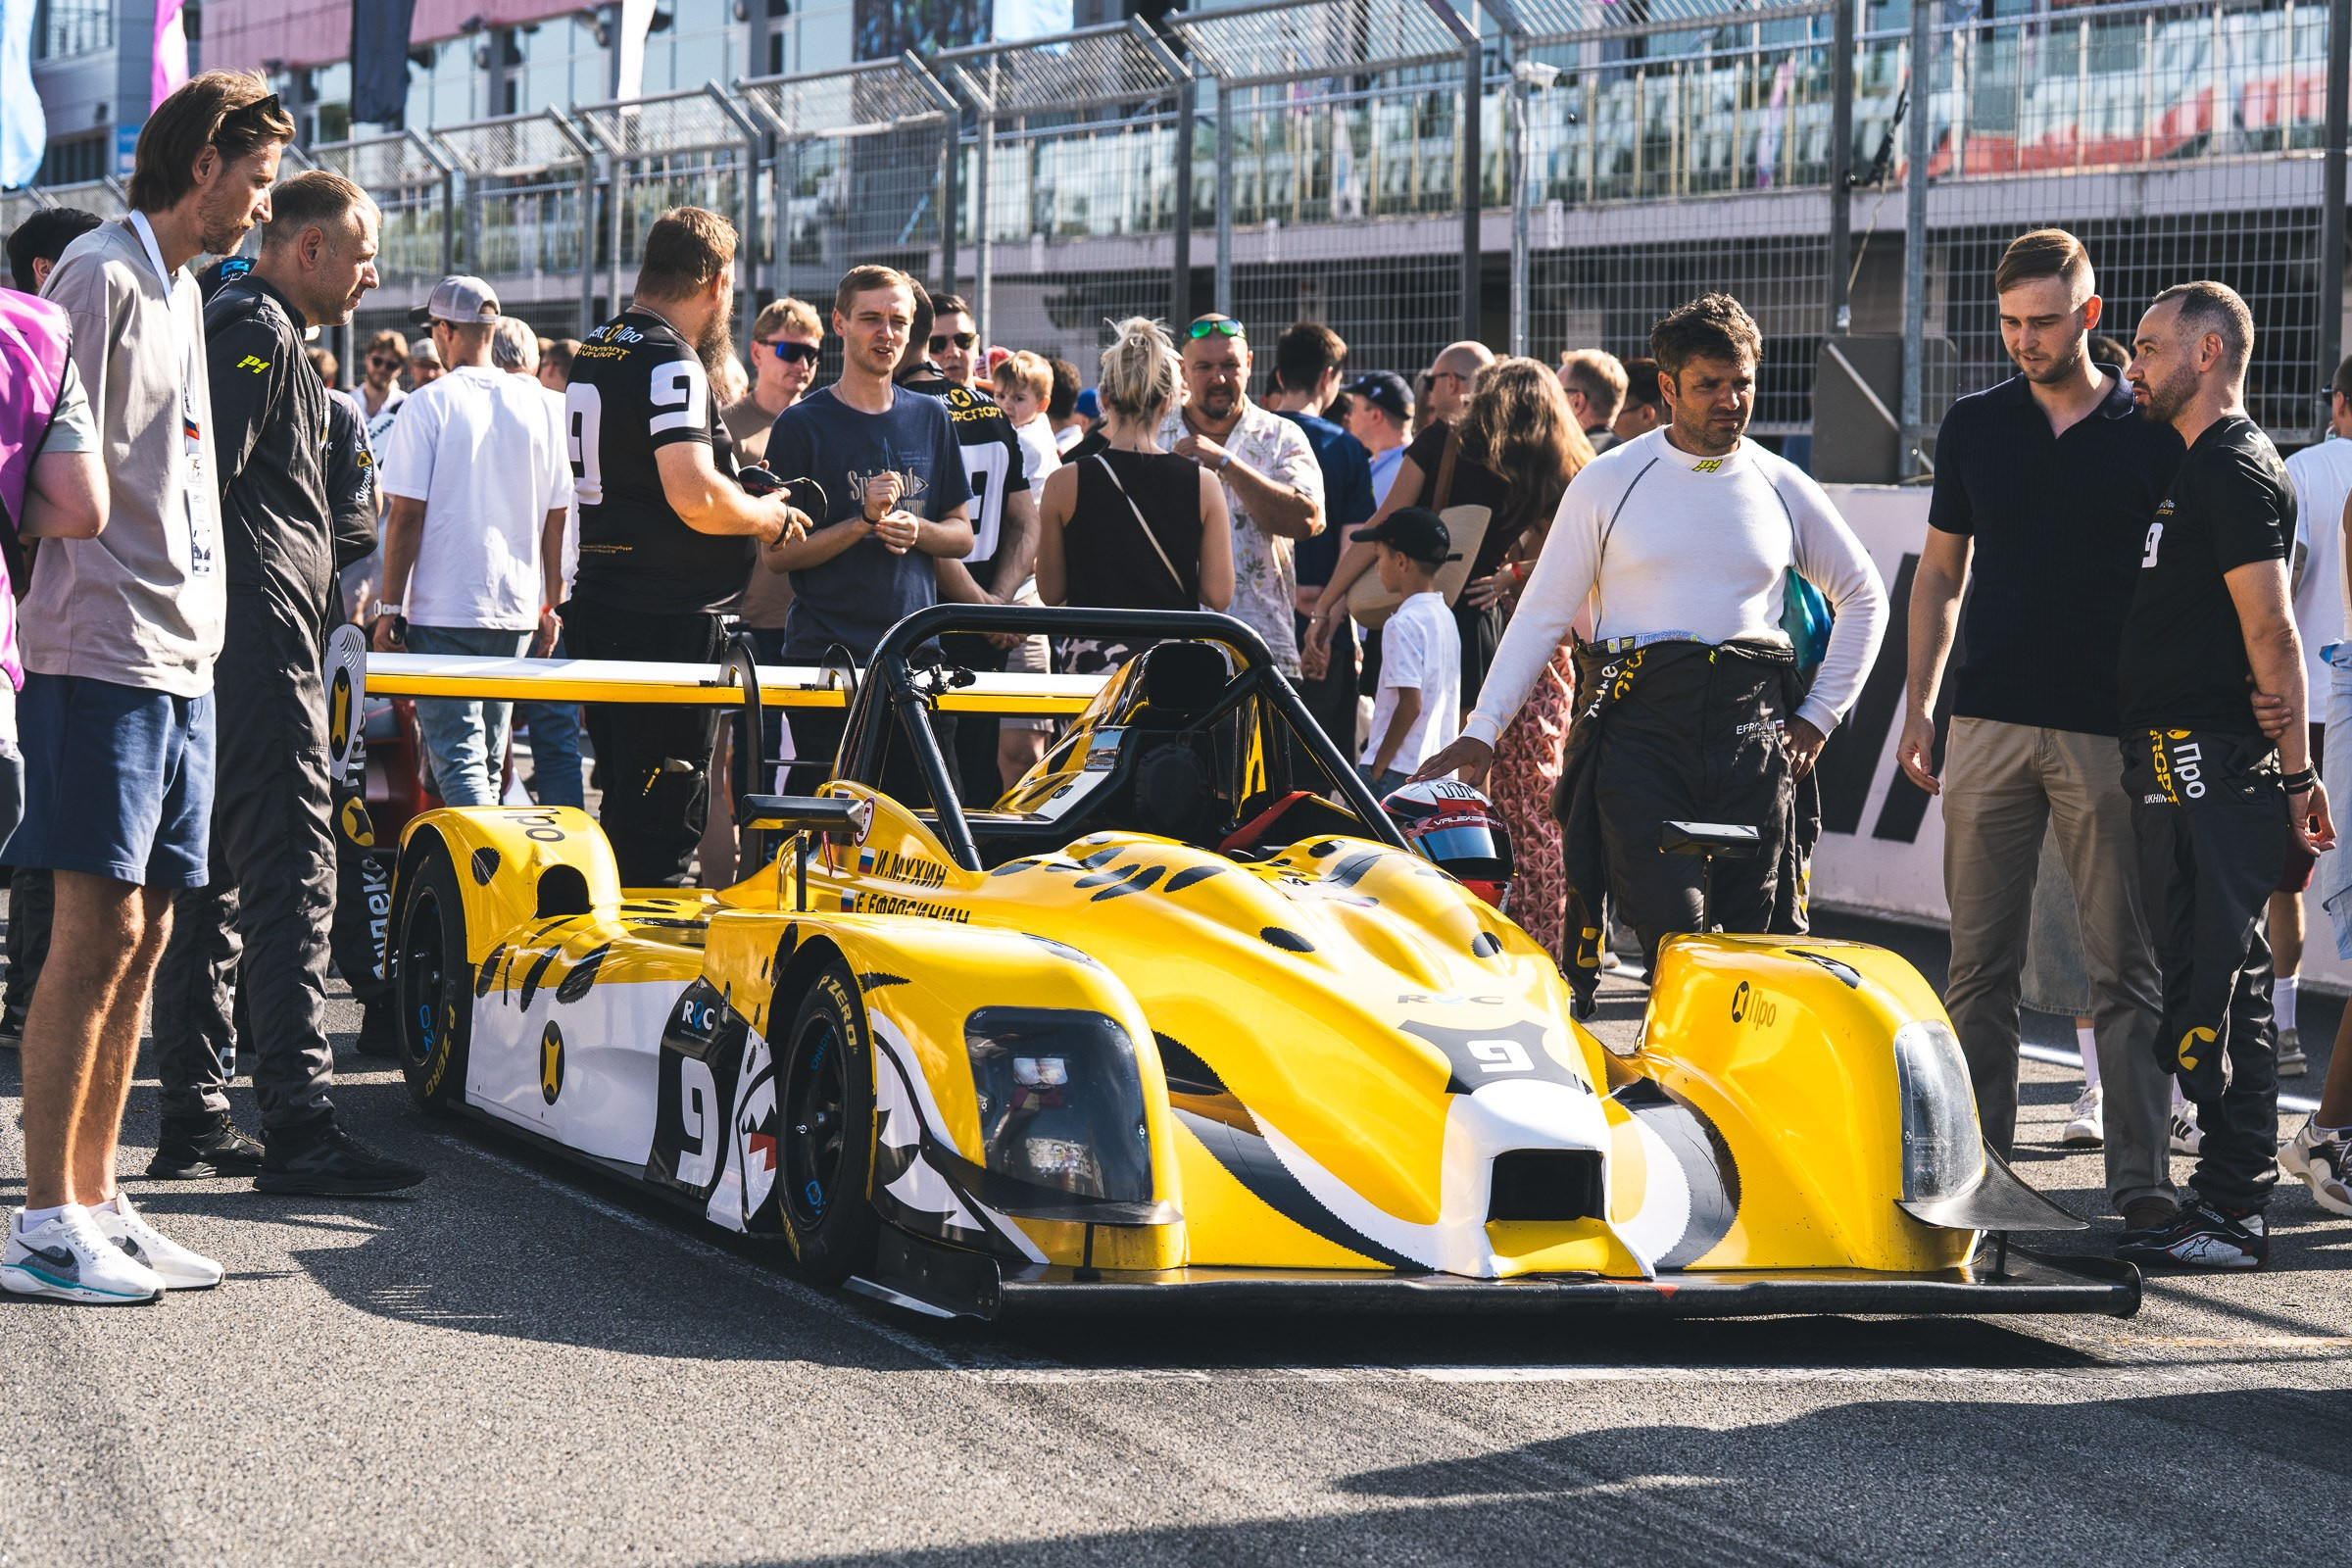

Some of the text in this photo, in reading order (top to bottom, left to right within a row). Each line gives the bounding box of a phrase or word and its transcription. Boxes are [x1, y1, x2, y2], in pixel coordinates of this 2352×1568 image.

[650, 360, 709, 436] 9
[2174, 742, 2206, 799] Про
[827, 979, 858, 1047] ZERO
[1747, 989, 1777, 1031] Про
[1466, 1039, 1536, 1073] 9
[676, 1055, 719, 1188] 9
